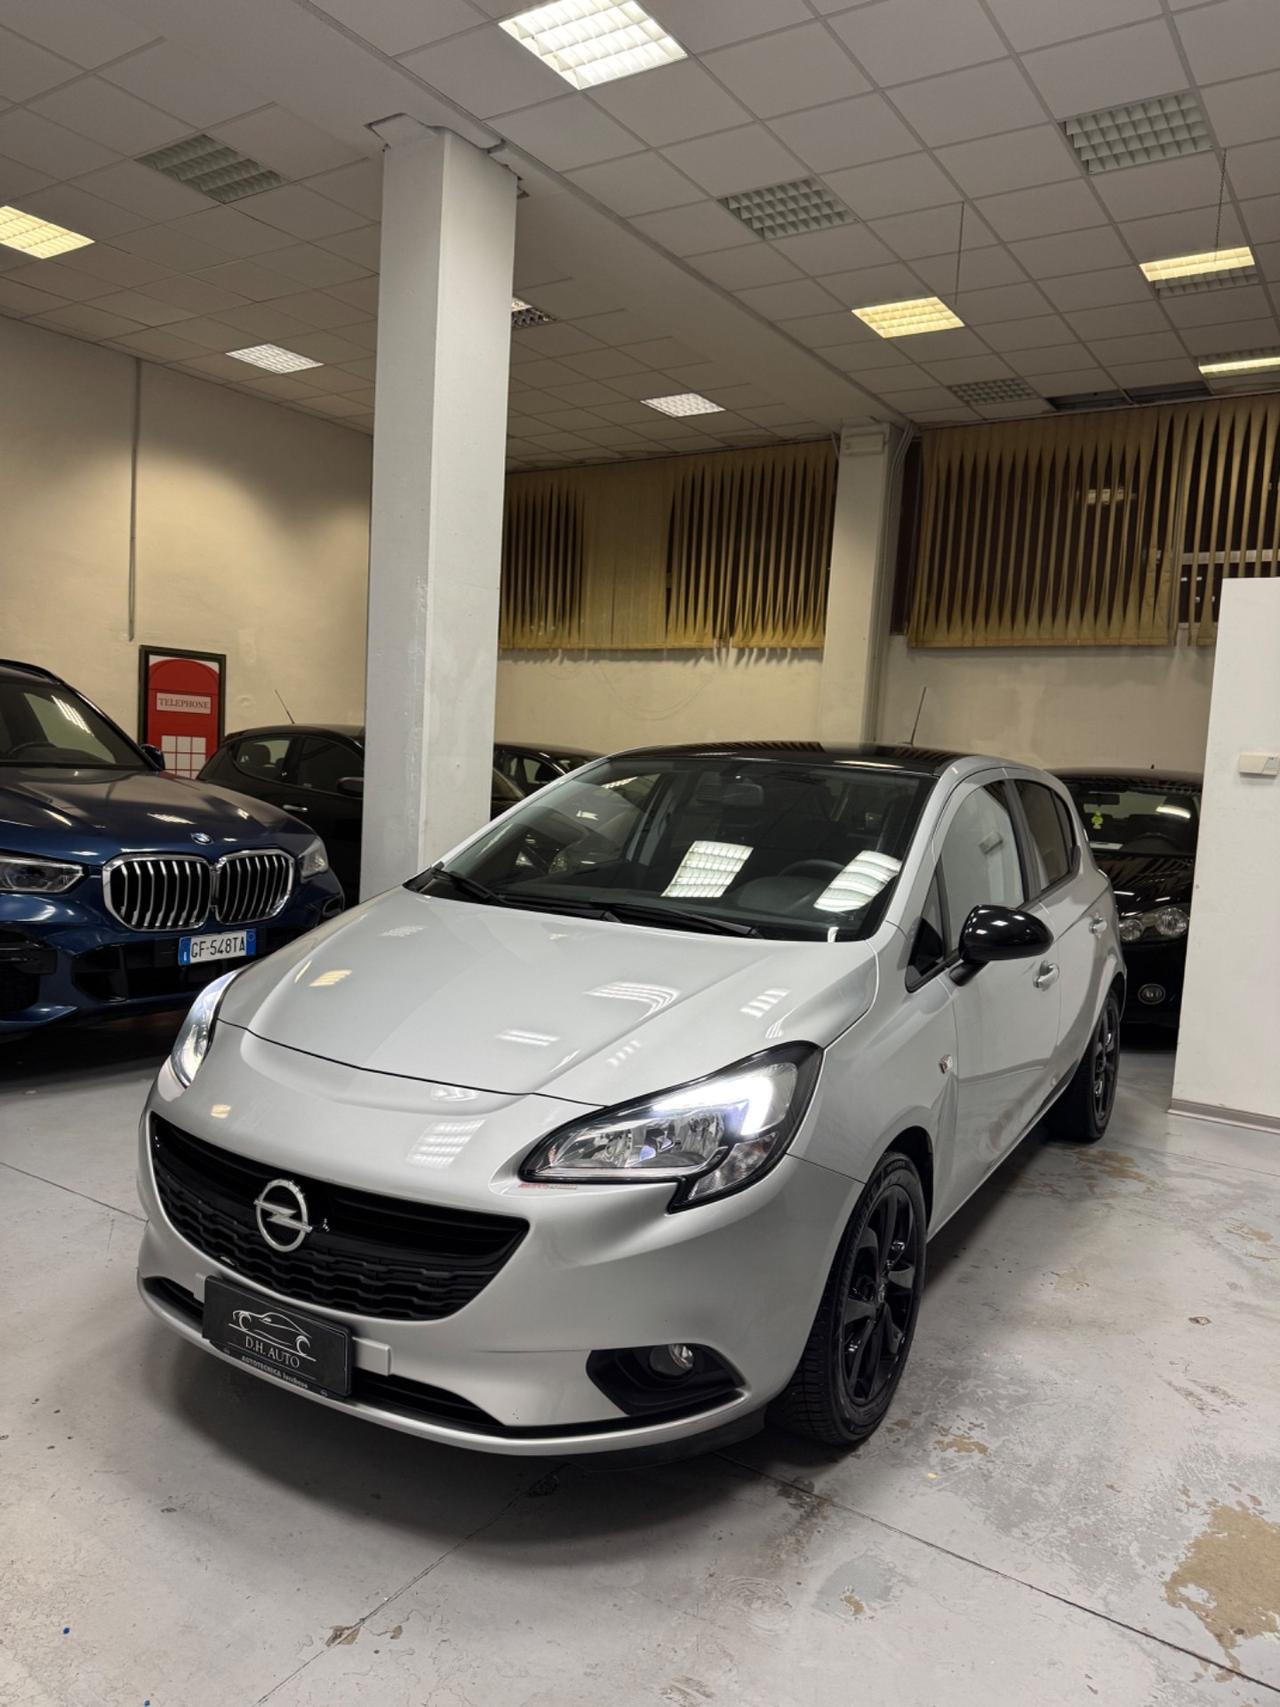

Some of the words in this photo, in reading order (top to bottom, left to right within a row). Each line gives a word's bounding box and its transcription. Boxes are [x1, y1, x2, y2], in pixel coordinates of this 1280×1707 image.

[158, 697, 209, 708] TELEPHONE
[245, 1335, 267, 1356] D.H.
[267, 1347, 300, 1369] AUTO
